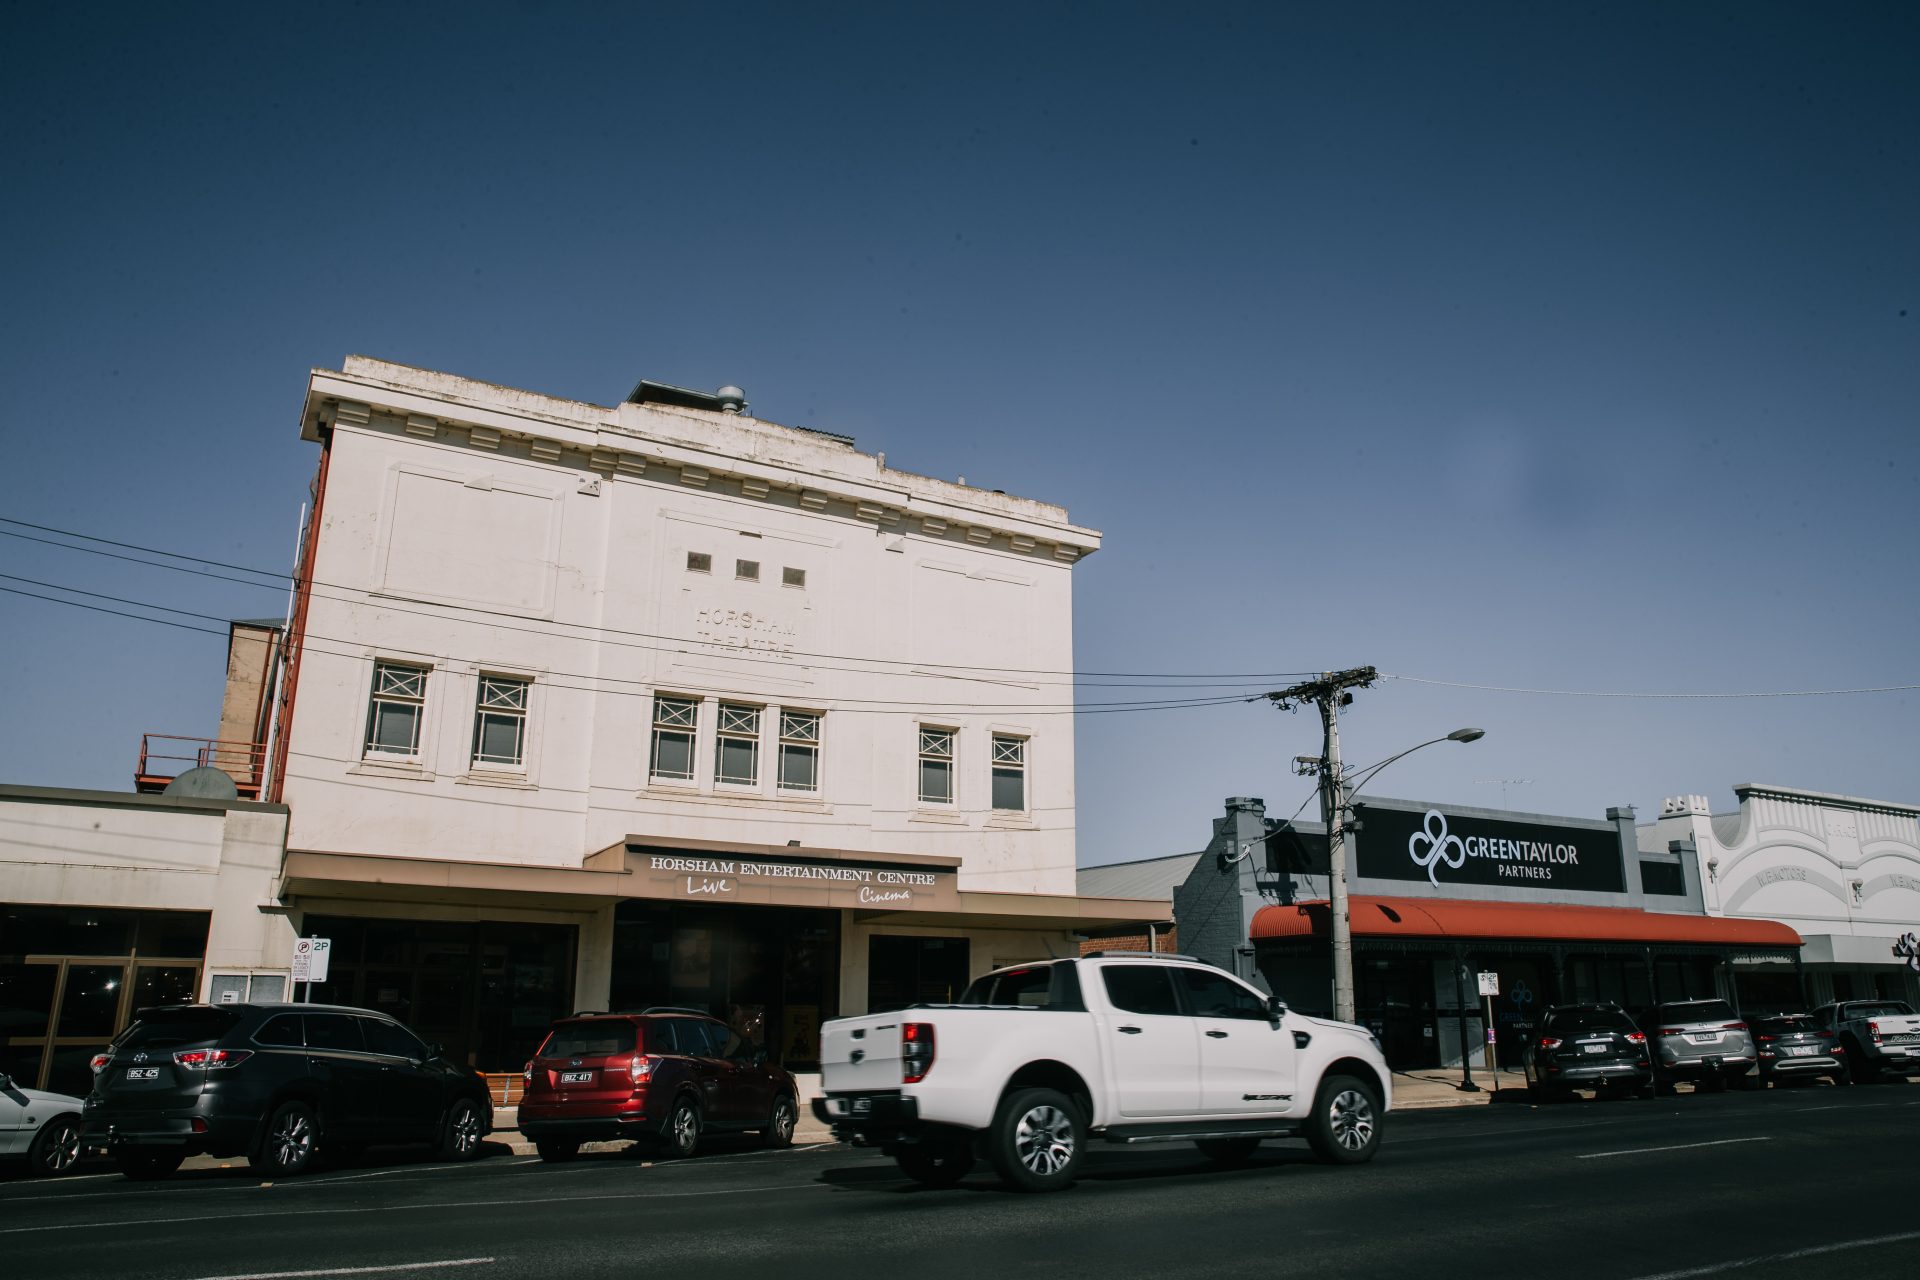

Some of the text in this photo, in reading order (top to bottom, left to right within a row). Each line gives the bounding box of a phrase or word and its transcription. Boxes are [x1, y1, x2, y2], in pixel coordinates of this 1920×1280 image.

[697, 607, 797, 637] HORSHAM
[697, 630, 795, 660] THEATRE
[1465, 836, 1579, 865] GREENTAYLOR
[650, 857, 936, 886] HORSHAM ENTERTAINMENT CENTRE
[1498, 864, 1552, 880] PARTNERS
[686, 876, 732, 895] Live
[859, 886, 911, 904] Cinema
[313, 942, 329, 951] 2P
